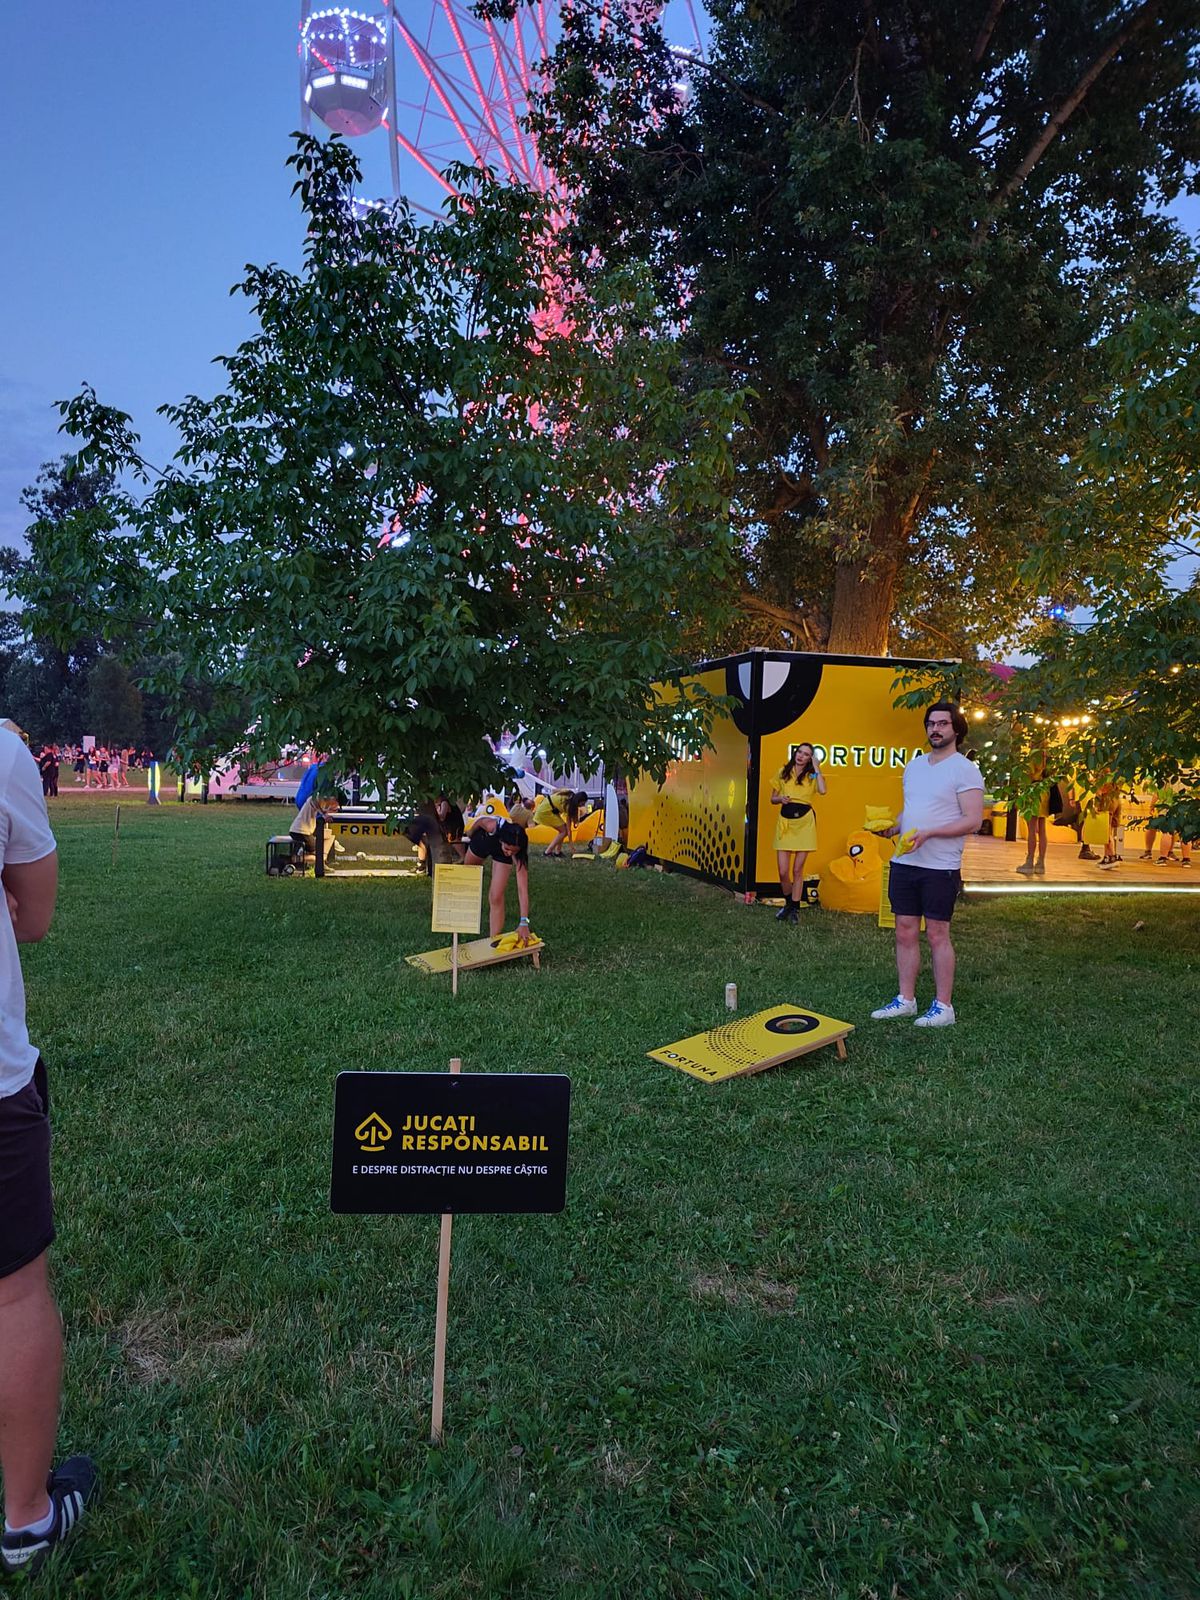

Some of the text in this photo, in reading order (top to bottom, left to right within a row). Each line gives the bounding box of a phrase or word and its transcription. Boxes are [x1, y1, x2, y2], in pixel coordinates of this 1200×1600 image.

[659, 1049, 719, 1077] FORTUNA
[402, 1135, 549, 1151] RESPONSABIL
[352, 1165, 358, 1174] E
[361, 1165, 397, 1174] DESPRE
[458, 1166, 473, 1174] NU
[476, 1166, 512, 1175] DESPRE
